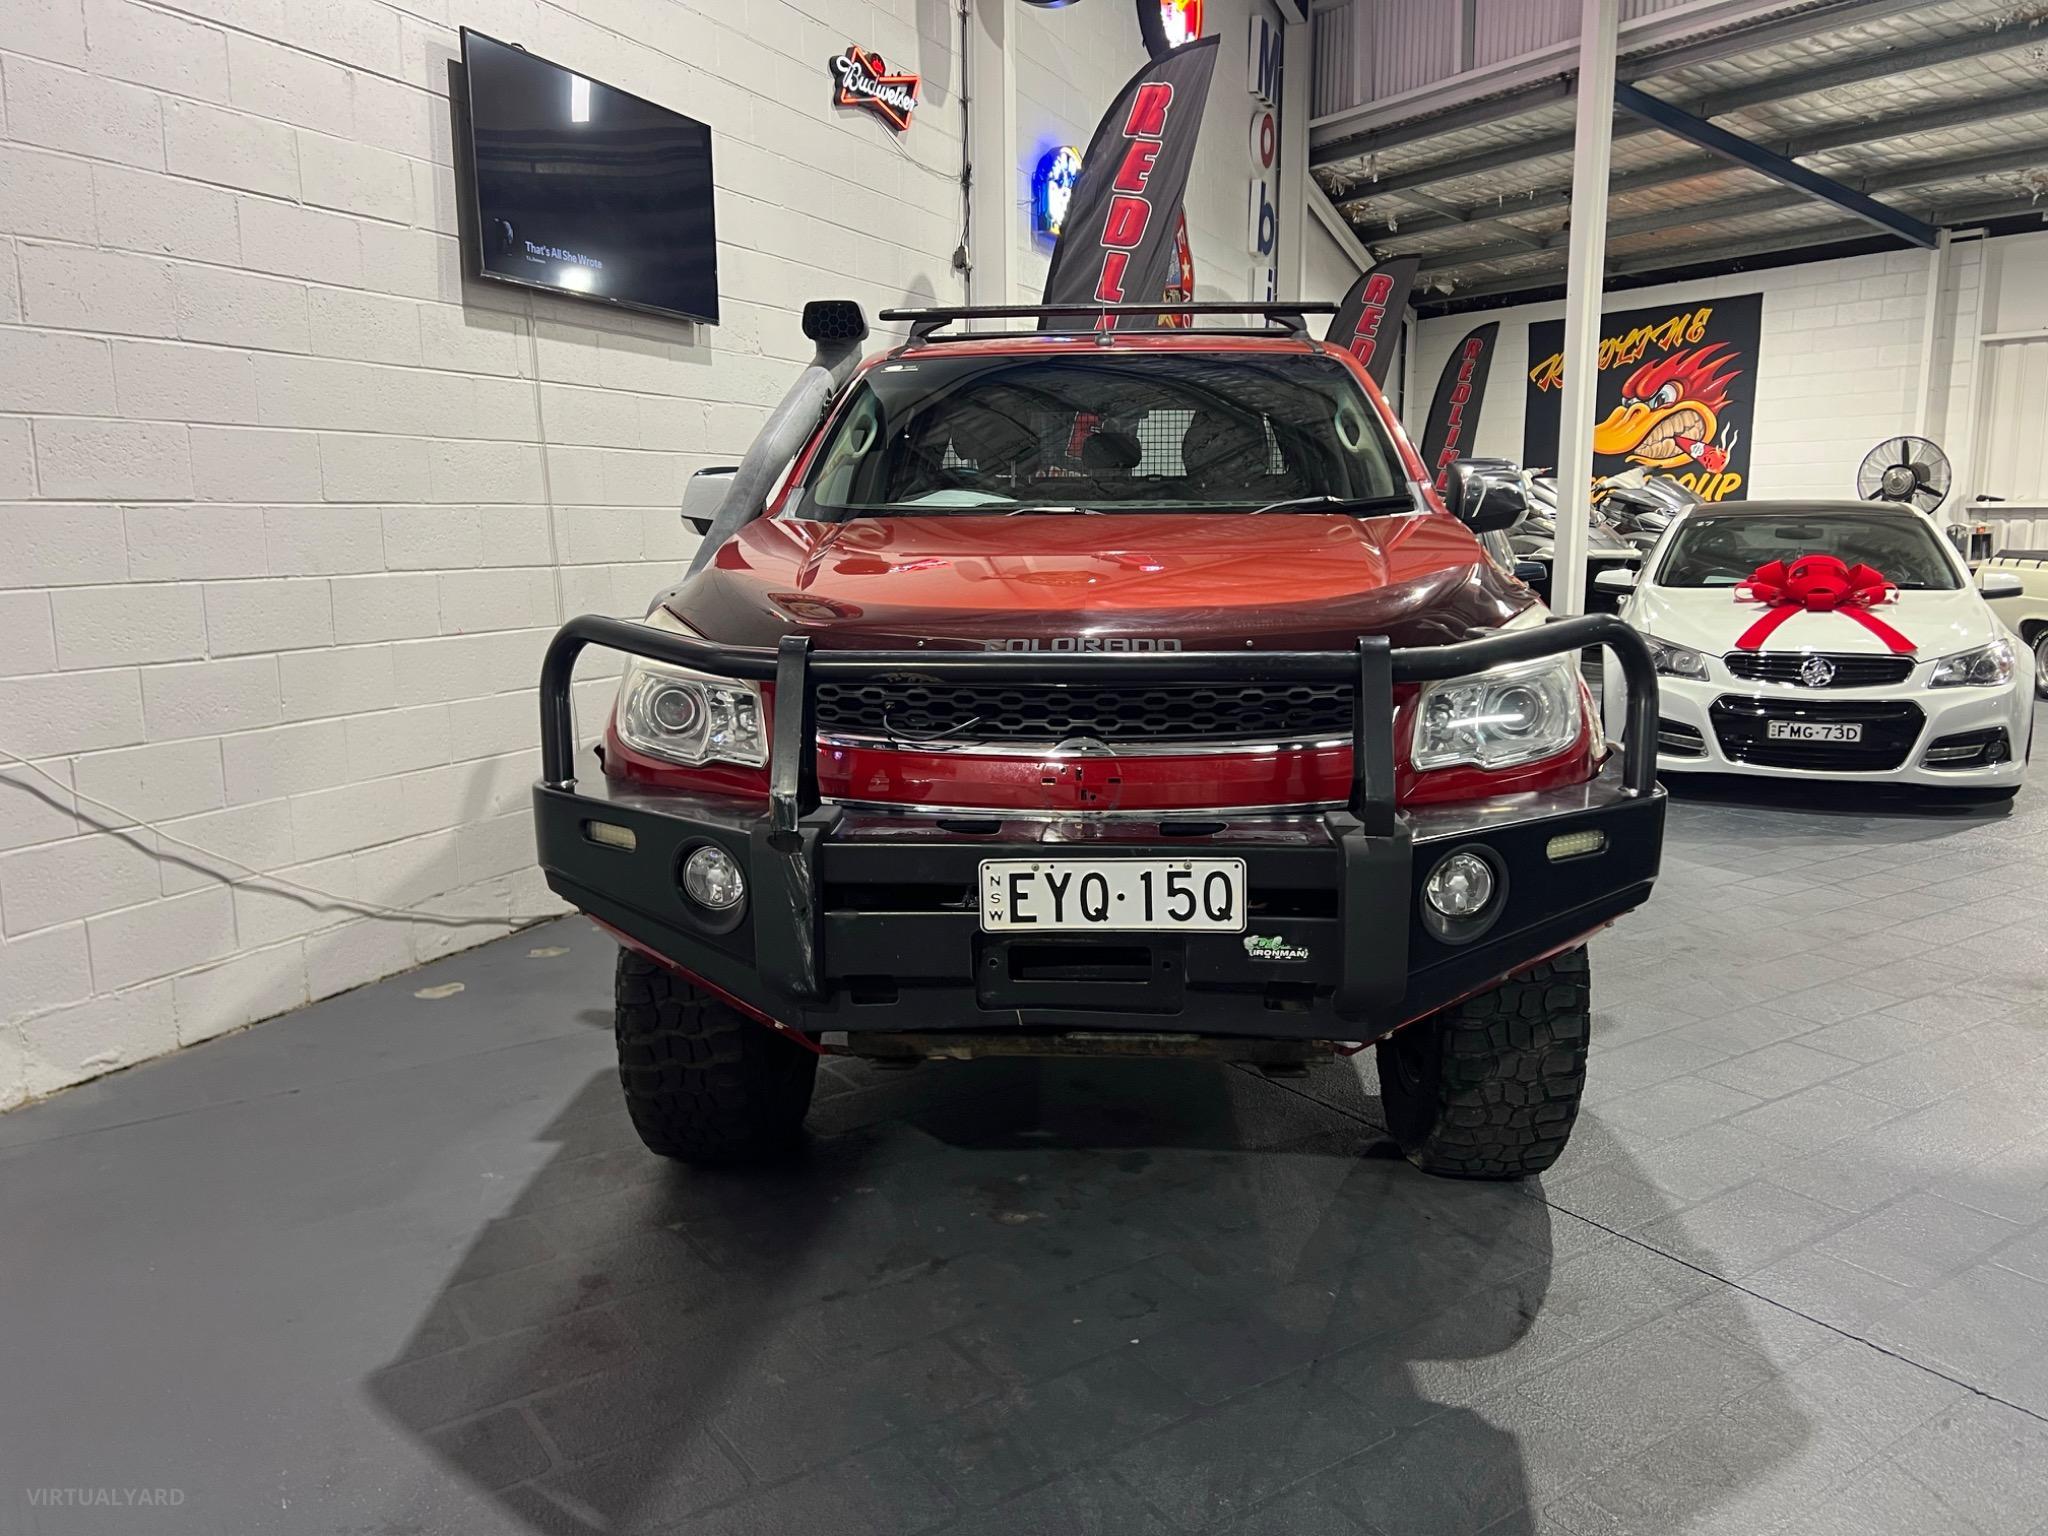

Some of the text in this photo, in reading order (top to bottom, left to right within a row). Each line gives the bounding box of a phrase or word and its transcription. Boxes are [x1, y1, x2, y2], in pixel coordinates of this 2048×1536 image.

[836, 55, 915, 112] Budweiser
[525, 240, 551, 257] That's
[551, 247, 562, 260] All
[562, 250, 577, 263] She
[577, 253, 603, 269] Wrote
[1529, 297, 1724, 393] RDLINE
[1253, 949, 1305, 957] IRONMAN
